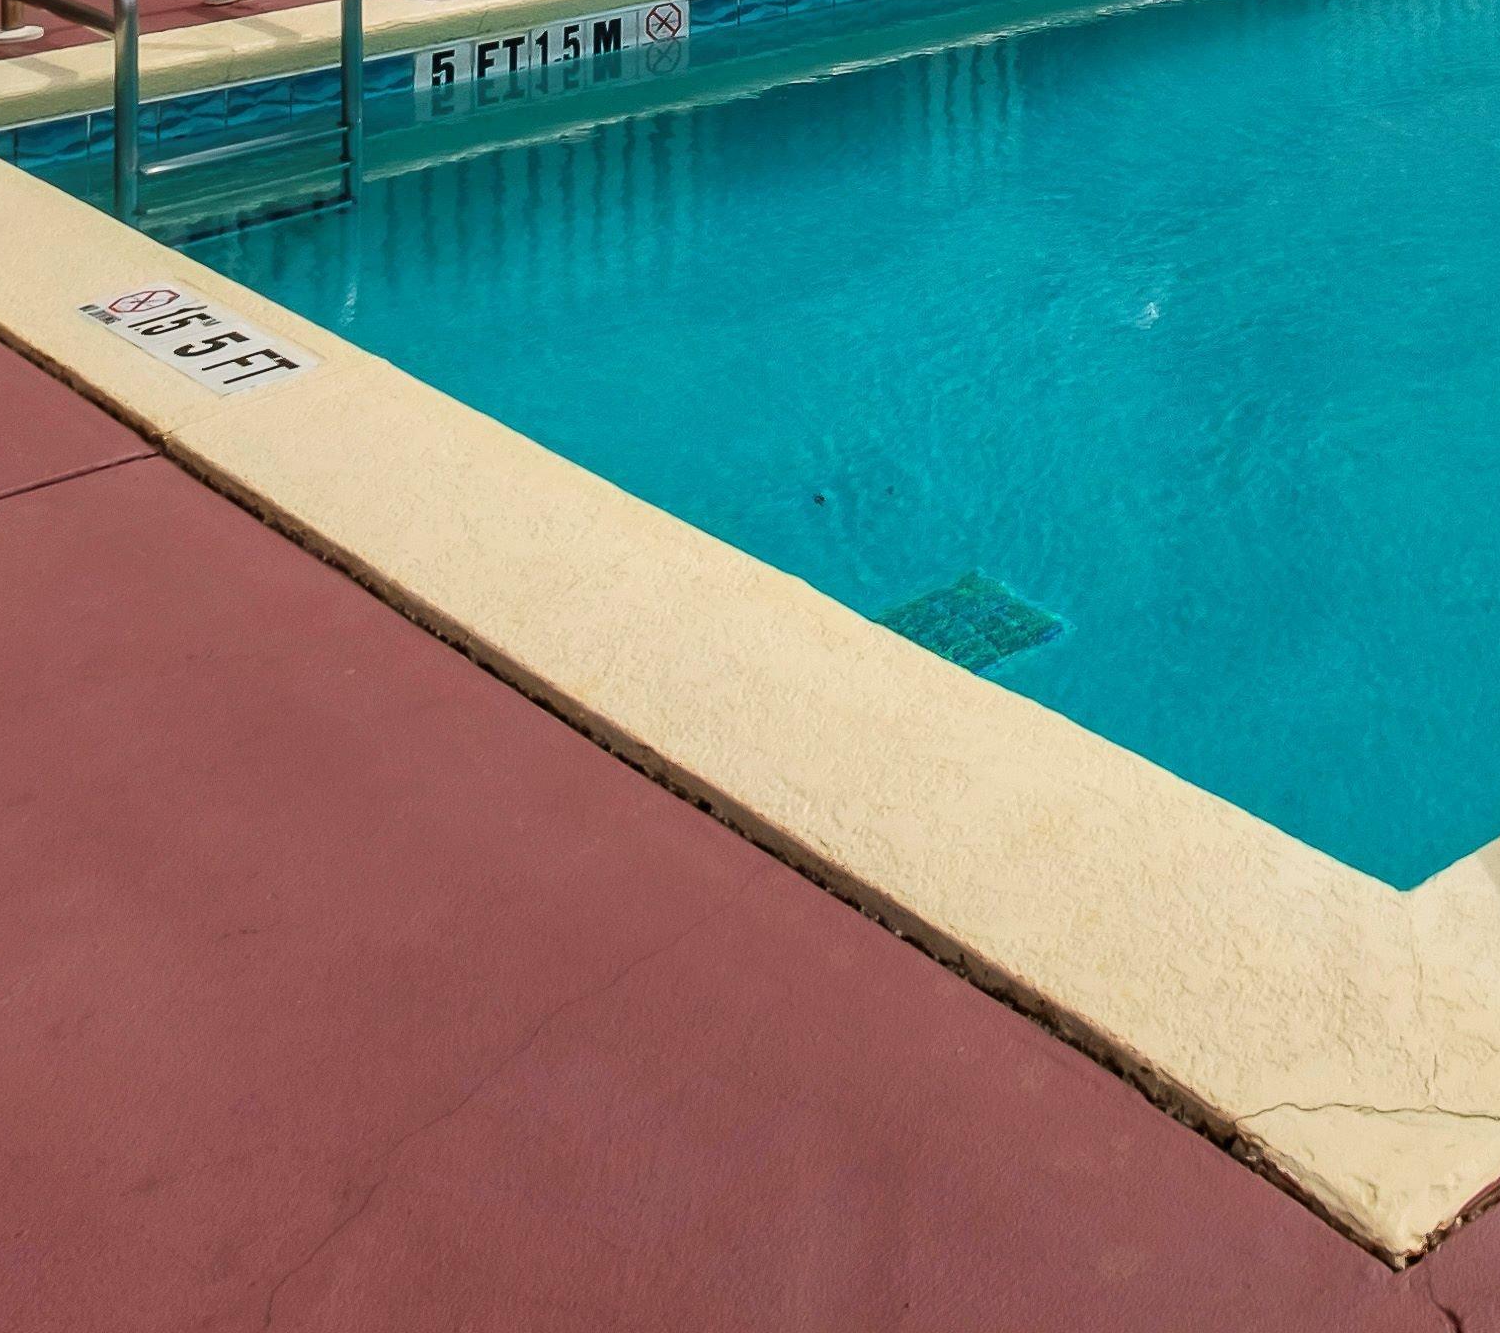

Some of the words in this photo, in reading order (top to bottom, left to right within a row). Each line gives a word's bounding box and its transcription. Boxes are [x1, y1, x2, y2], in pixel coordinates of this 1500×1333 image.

[431, 49, 455, 87] 5
[477, 36, 526, 81] FT
[594, 17, 621, 54] M
[174, 331, 250, 357] 5
[202, 348, 300, 384] FT
